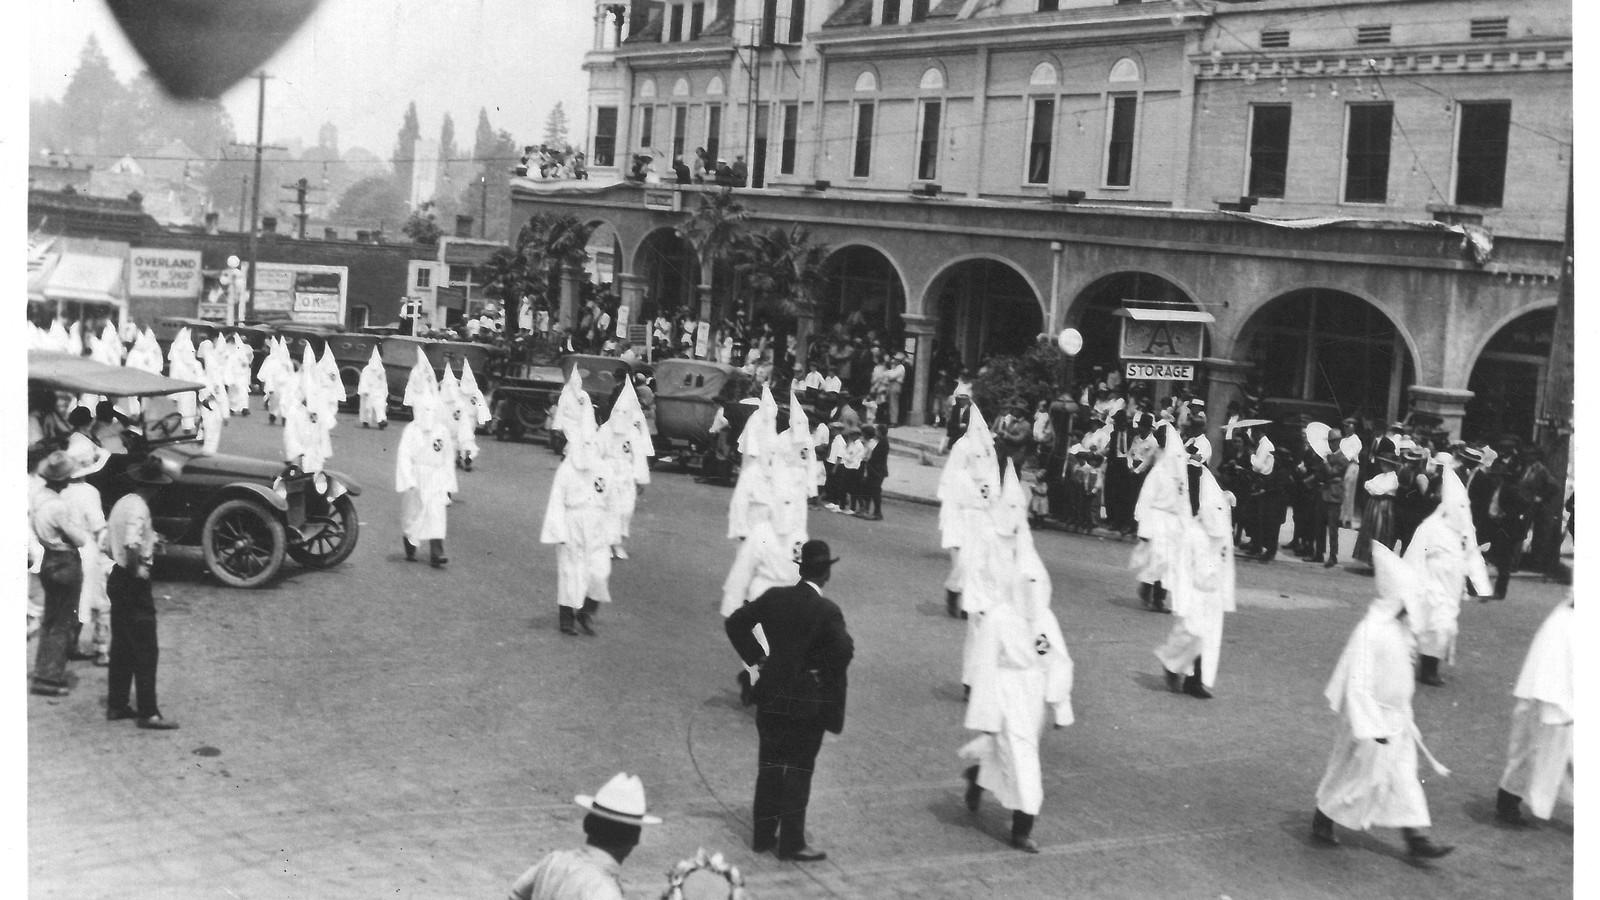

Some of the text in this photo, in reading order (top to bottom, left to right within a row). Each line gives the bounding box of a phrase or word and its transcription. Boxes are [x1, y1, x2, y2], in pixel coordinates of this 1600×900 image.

[134, 256, 196, 269] OVERLAND
[168, 269, 194, 281] SHOP
[1127, 364, 1190, 378] STORAGE
